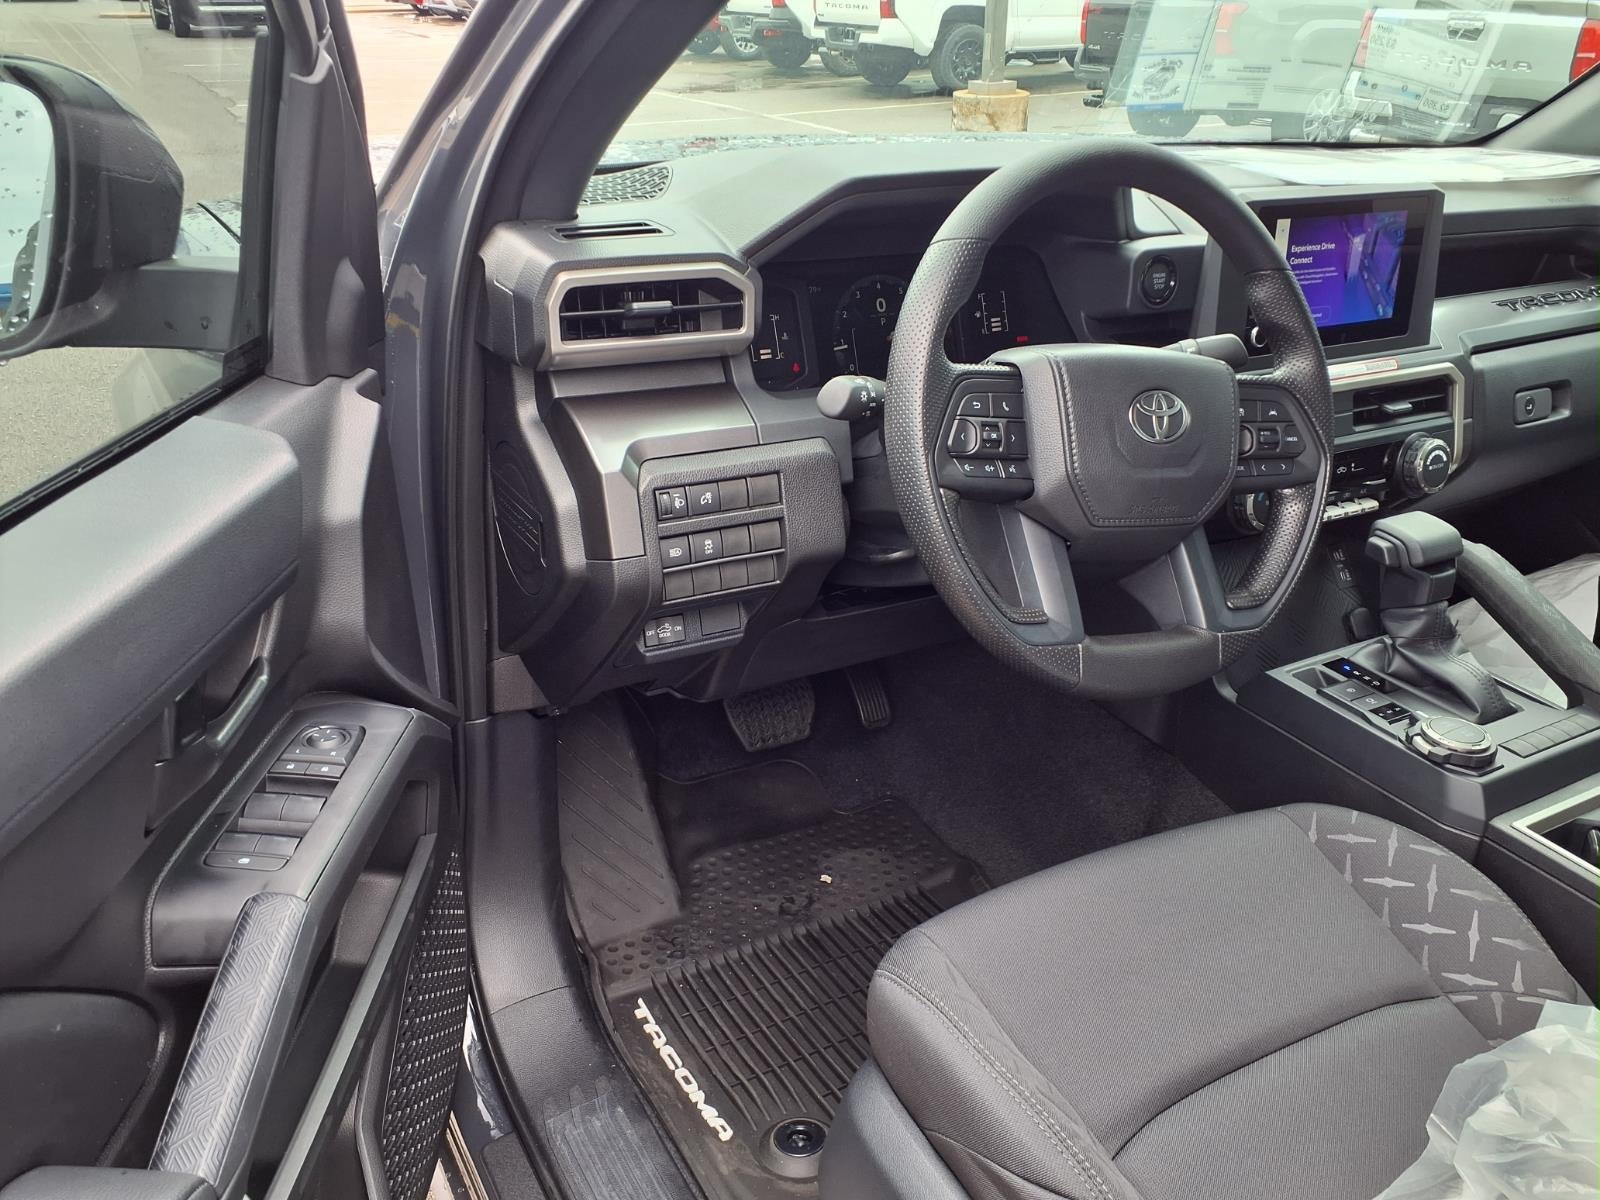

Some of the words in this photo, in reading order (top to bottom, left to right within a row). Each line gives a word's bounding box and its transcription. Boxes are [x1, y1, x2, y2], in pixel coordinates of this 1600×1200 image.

[1291, 243, 1321, 253] Experience
[1321, 242, 1336, 250] Drive
[1290, 256, 1313, 265] Connect
[634, 997, 734, 1142] TACOMA
